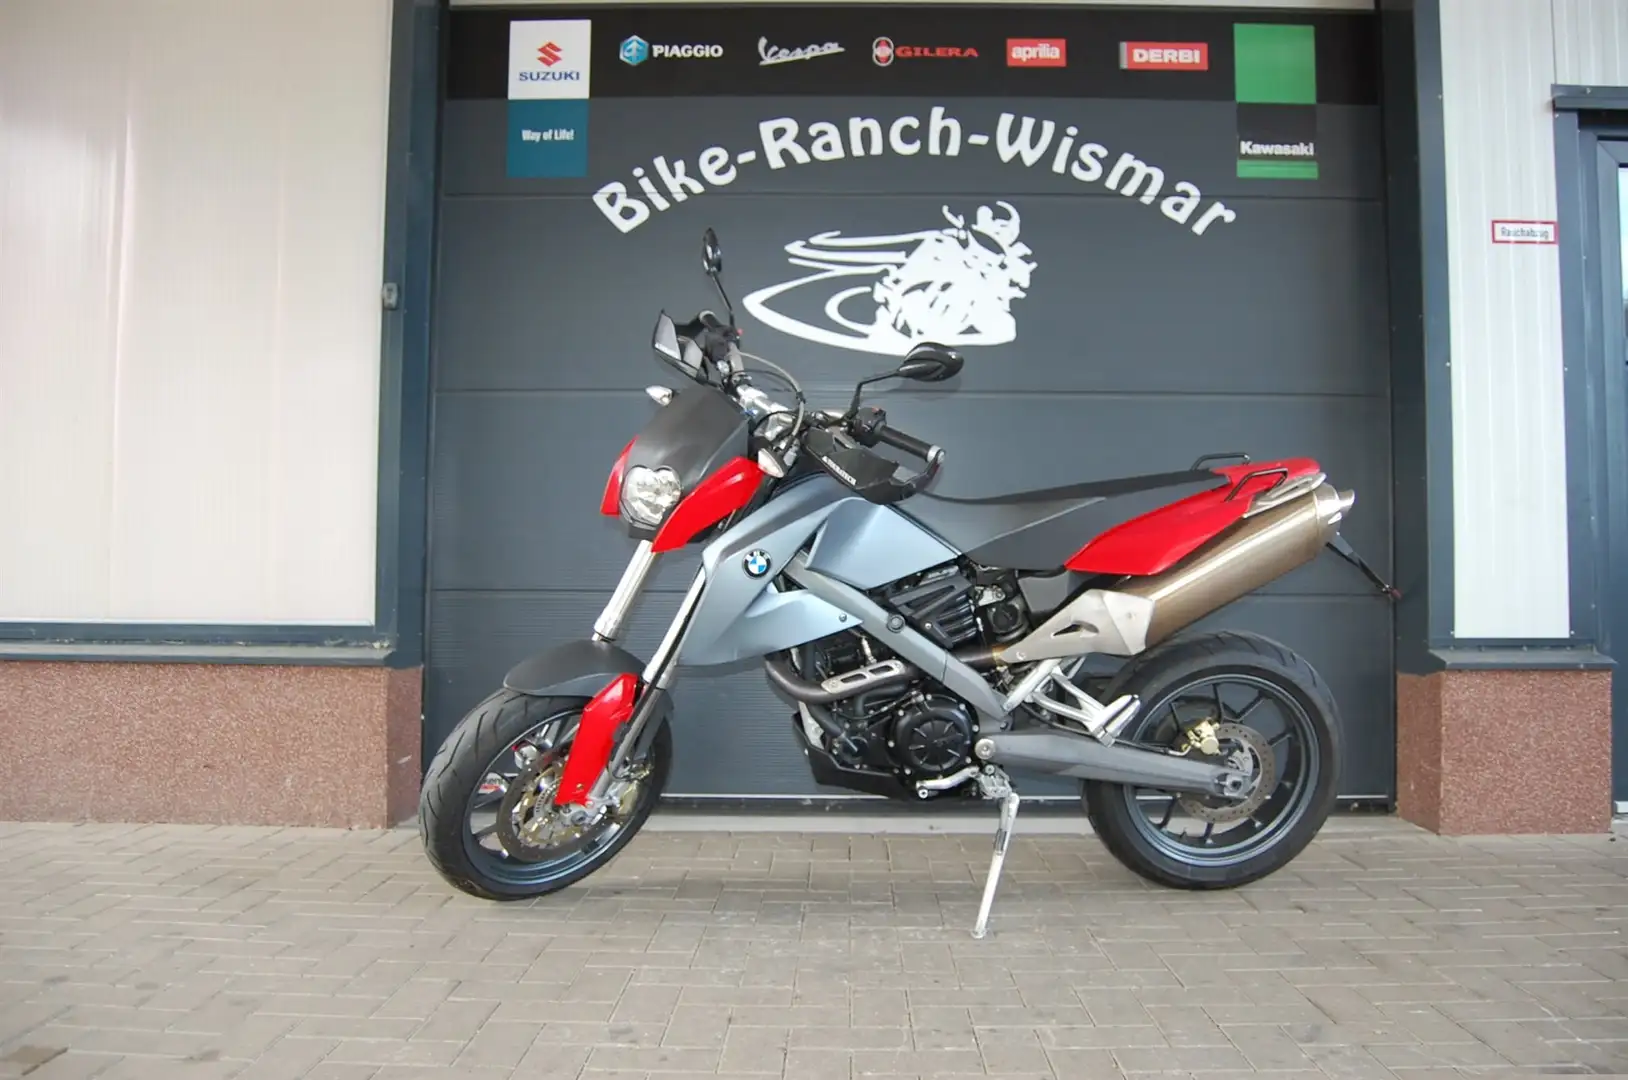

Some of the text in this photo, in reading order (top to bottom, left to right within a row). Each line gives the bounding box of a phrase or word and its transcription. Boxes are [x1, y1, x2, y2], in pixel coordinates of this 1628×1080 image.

[652, 44, 724, 58] PIAGGIO
[758, 36, 845, 66] Vespa
[895, 46, 979, 58] GILERA
[1012, 43, 1060, 62] aprilia
[1133, 48, 1200, 63] DERBI
[519, 71, 580, 82] SUZUKI
[522, 129, 541, 143] Way
[543, 129, 552, 140] of
[1240, 141, 1314, 156] Kawasaki
[592, 106, 1237, 234] Bike-Ranch-Wismar
